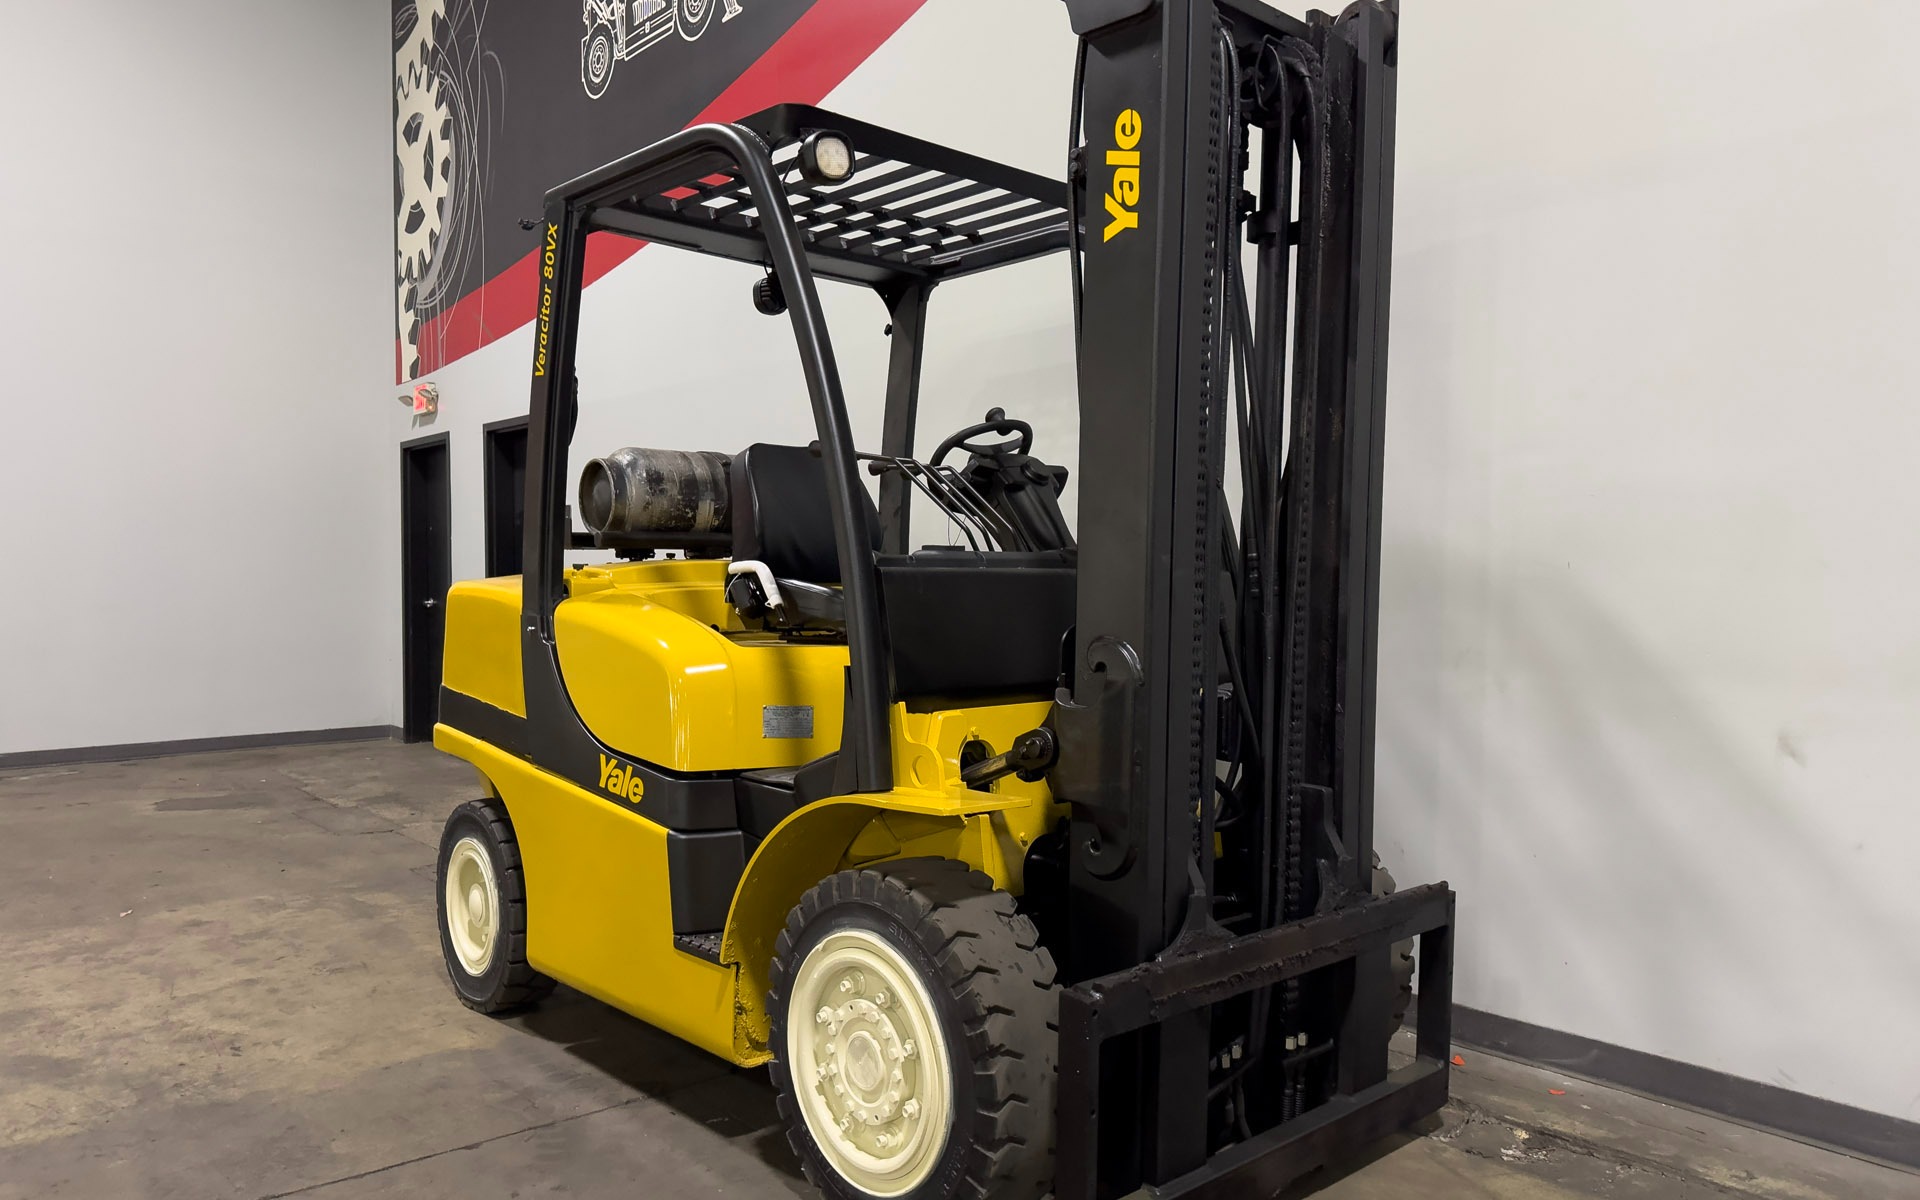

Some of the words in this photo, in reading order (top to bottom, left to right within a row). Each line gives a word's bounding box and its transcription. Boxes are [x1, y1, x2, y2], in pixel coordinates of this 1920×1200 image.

[1103, 108, 1143, 244] Yale
[534, 283, 552, 377] Veracitor
[543, 222, 559, 280] 80VX
[599, 753, 644, 804] Yale
